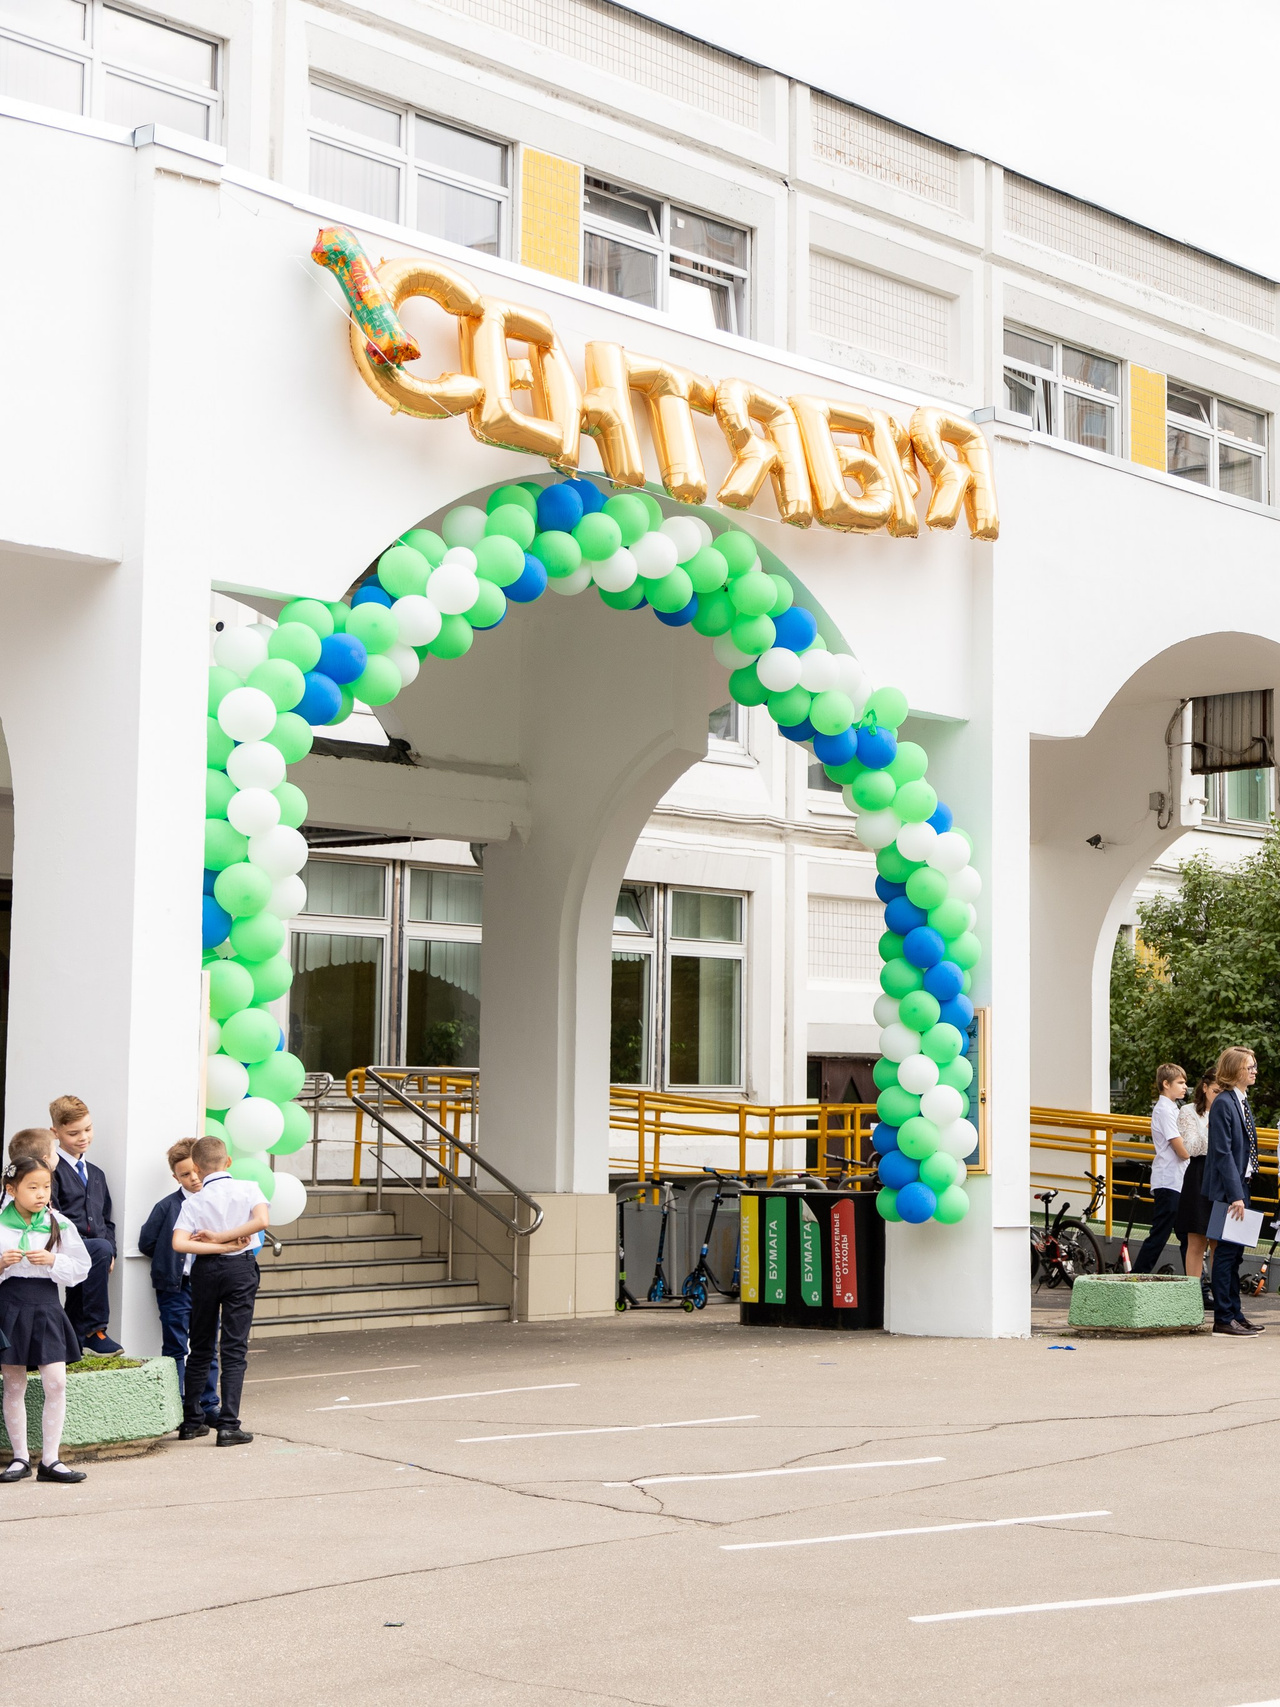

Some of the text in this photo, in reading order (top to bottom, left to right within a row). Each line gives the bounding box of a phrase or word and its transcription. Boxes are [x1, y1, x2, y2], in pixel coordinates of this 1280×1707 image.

[311, 226, 422, 371] 1
[742, 1215, 750, 1285] ПЛАСТИК
[769, 1220, 778, 1280] БУМАГА
[804, 1222, 813, 1282] БУМАГА
[833, 1213, 842, 1296] НЕСОРТИРУЕМЫЕ
[841, 1234, 849, 1275] ОТХОДЫ
